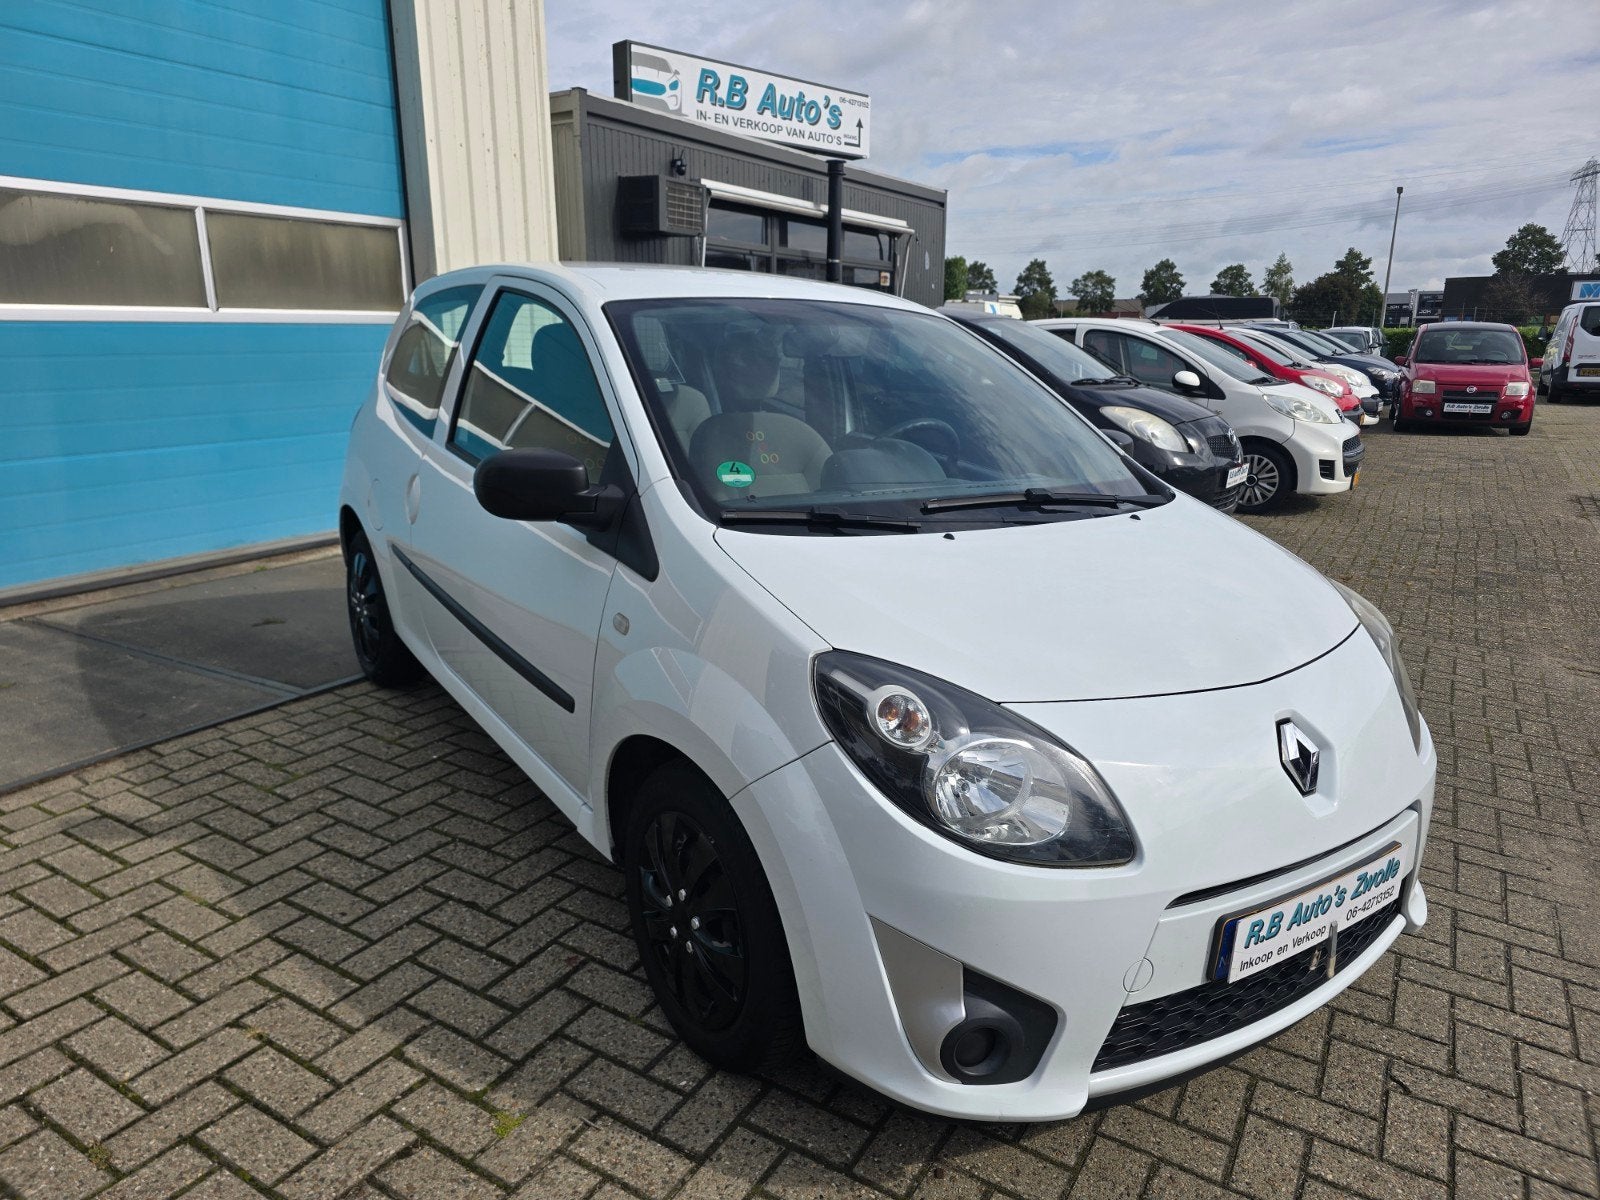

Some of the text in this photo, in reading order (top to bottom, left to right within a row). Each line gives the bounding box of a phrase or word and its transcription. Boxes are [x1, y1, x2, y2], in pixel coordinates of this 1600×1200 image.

[696, 68, 843, 130] R.B Auto's
[696, 109, 842, 146] IN- EN VERKOOP VAN AUTO'S
[729, 462, 741, 475] 4
[1239, 950, 1273, 972] Inkoop
[1276, 944, 1288, 956] en
[1292, 925, 1327, 948] Verkoop
[1346, 885, 1395, 922] 06-42713152
[1243, 857, 1401, 949] R.B Auto's Zwolle
